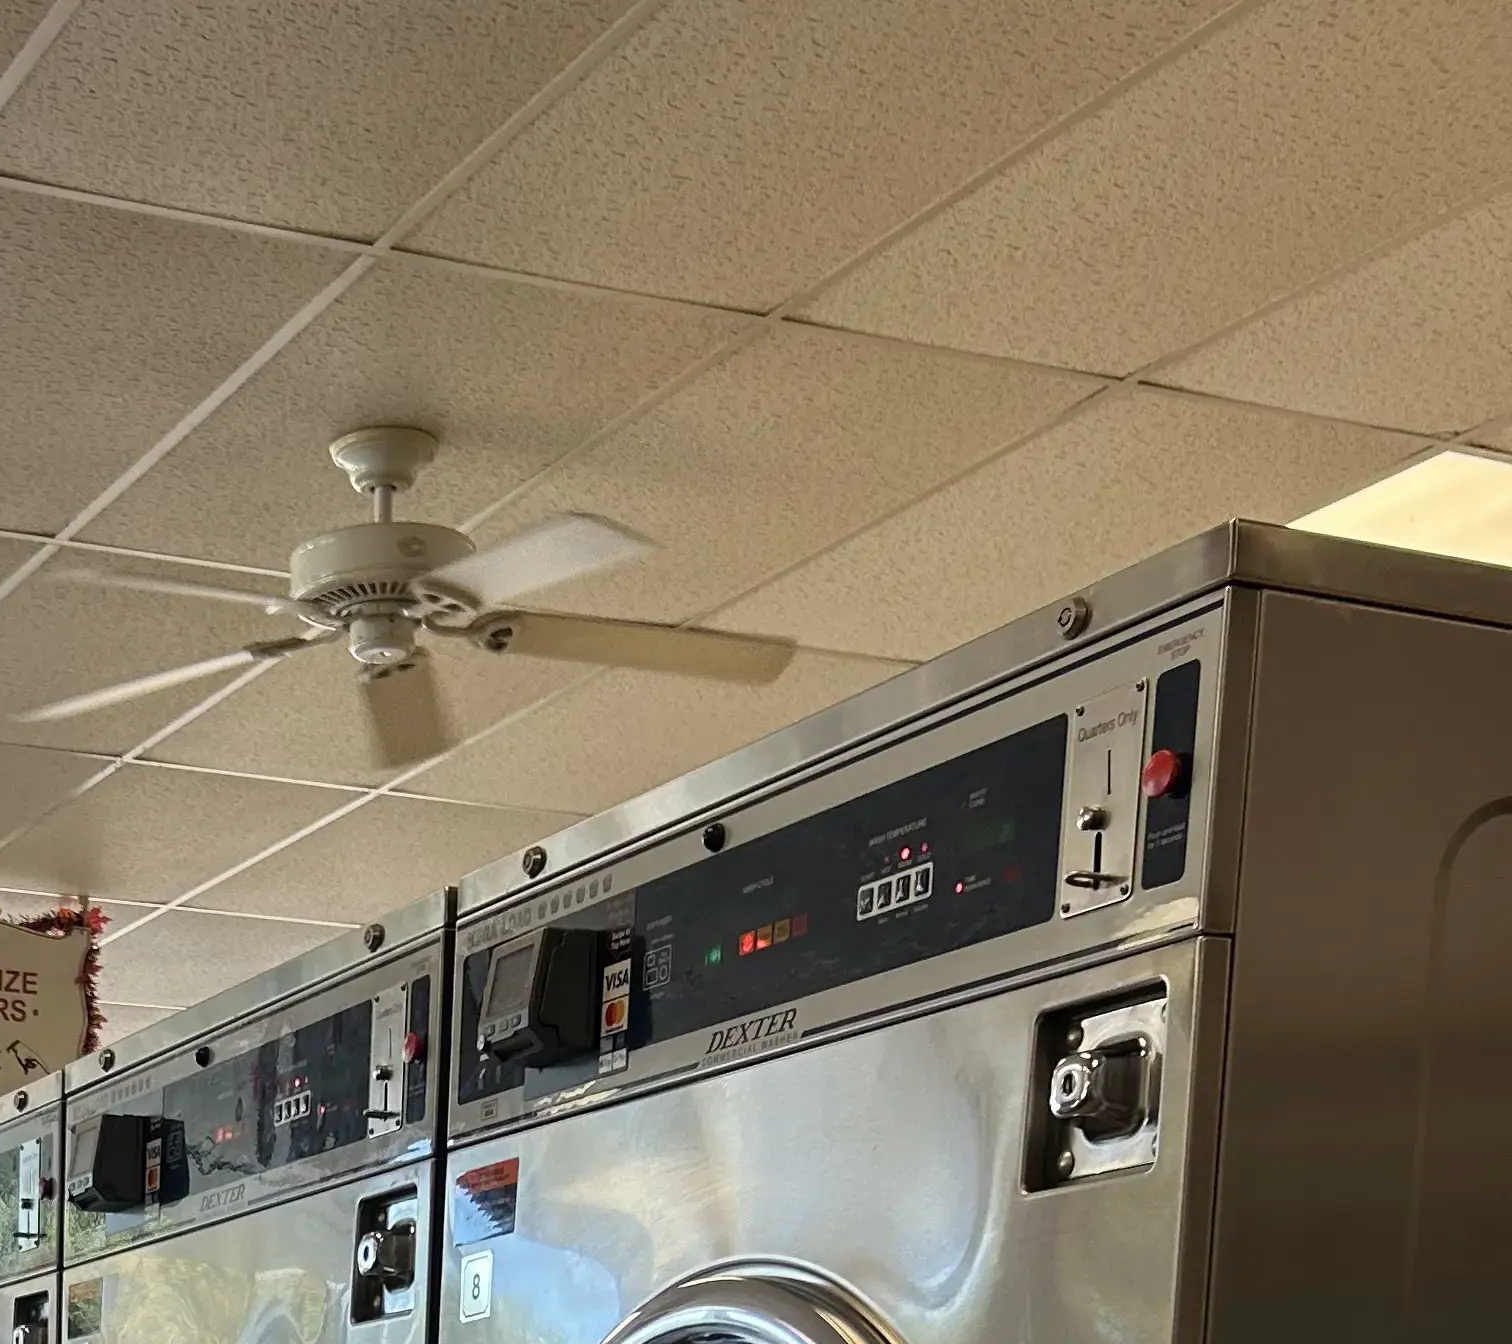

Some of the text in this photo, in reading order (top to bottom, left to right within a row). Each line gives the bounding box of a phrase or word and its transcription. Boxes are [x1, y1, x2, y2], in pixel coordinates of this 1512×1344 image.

[1077, 708, 1139, 743] Quarters Only
[605, 969, 629, 991] VISA
[705, 1007, 797, 1055] DEXTER
[201, 1183, 246, 1212] DEXTER
[472, 1273, 481, 1301] 8
